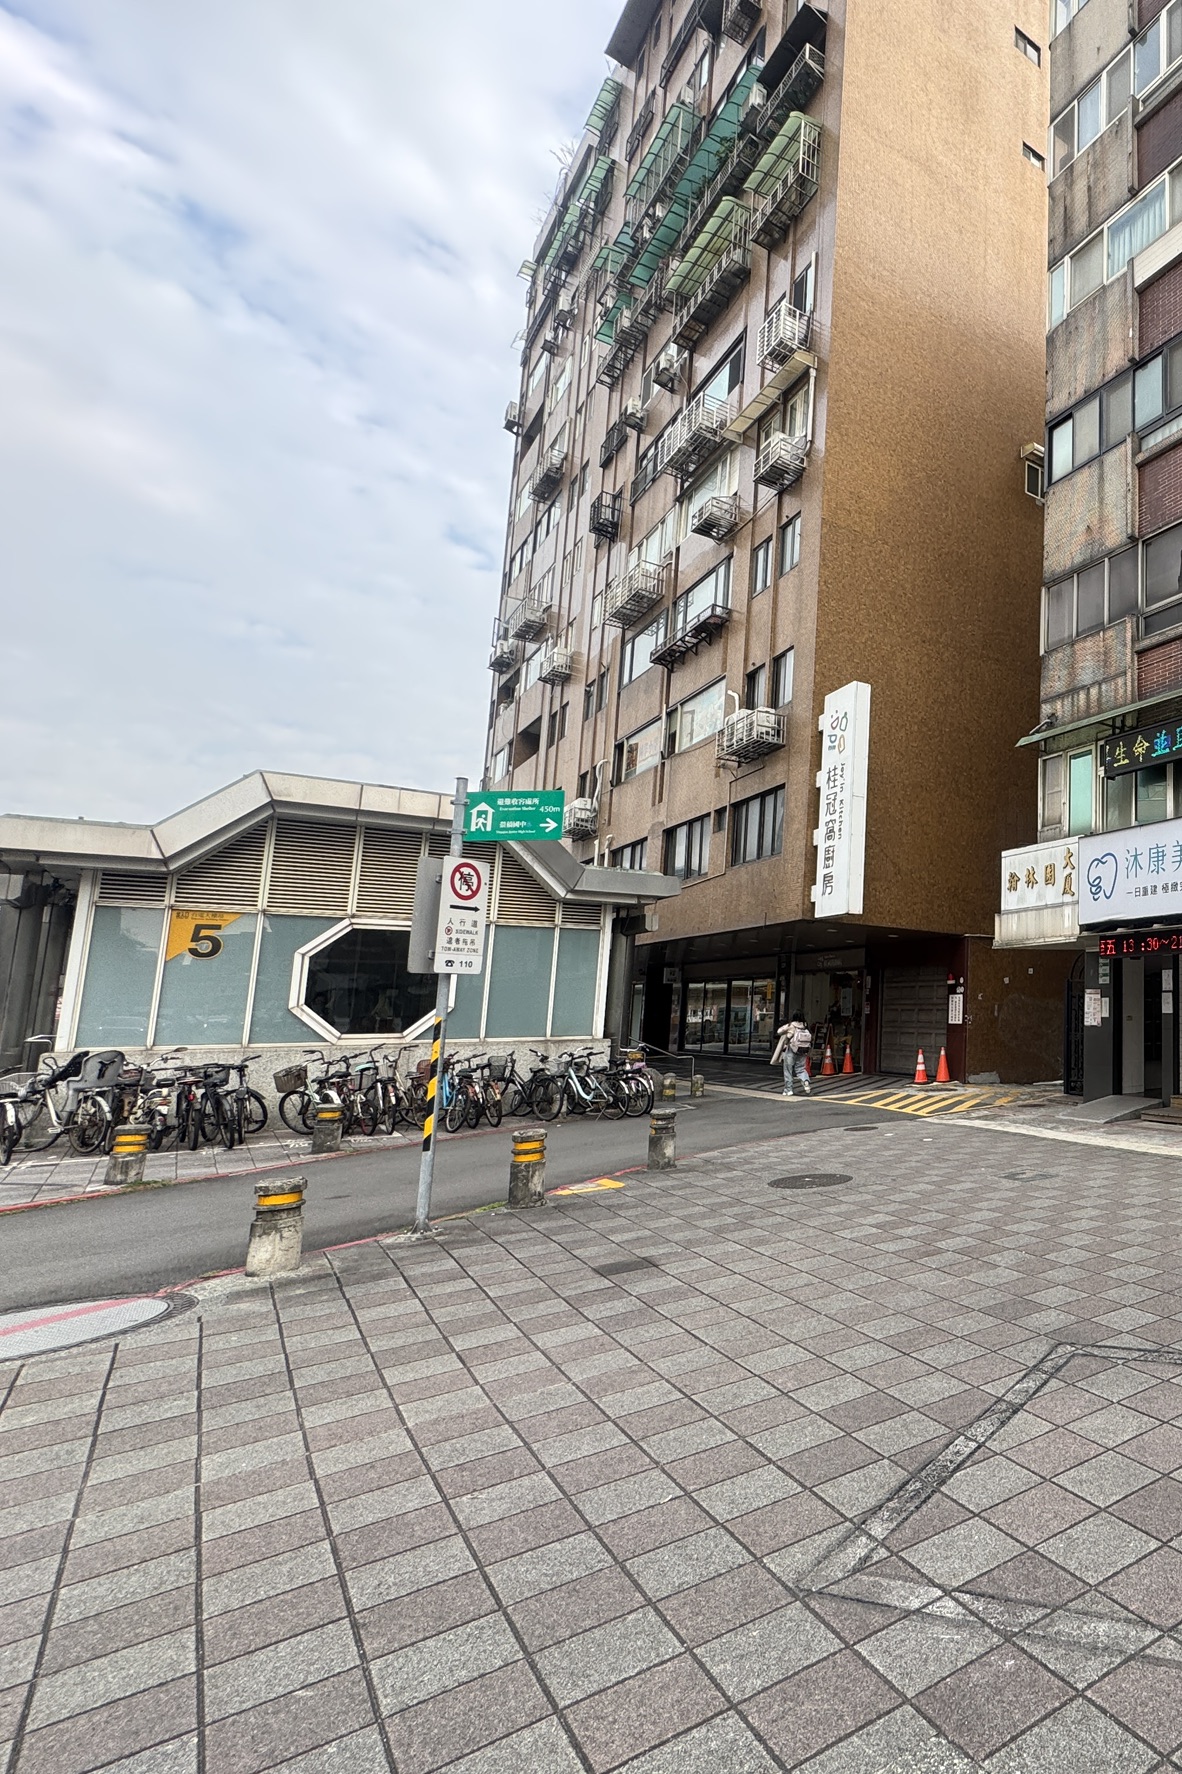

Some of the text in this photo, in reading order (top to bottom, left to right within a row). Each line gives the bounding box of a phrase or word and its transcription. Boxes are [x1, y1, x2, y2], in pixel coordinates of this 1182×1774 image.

[447, 917, 478, 929] 人行道
[187, 923, 223, 958] 5
[459, 960, 473, 968] 110
